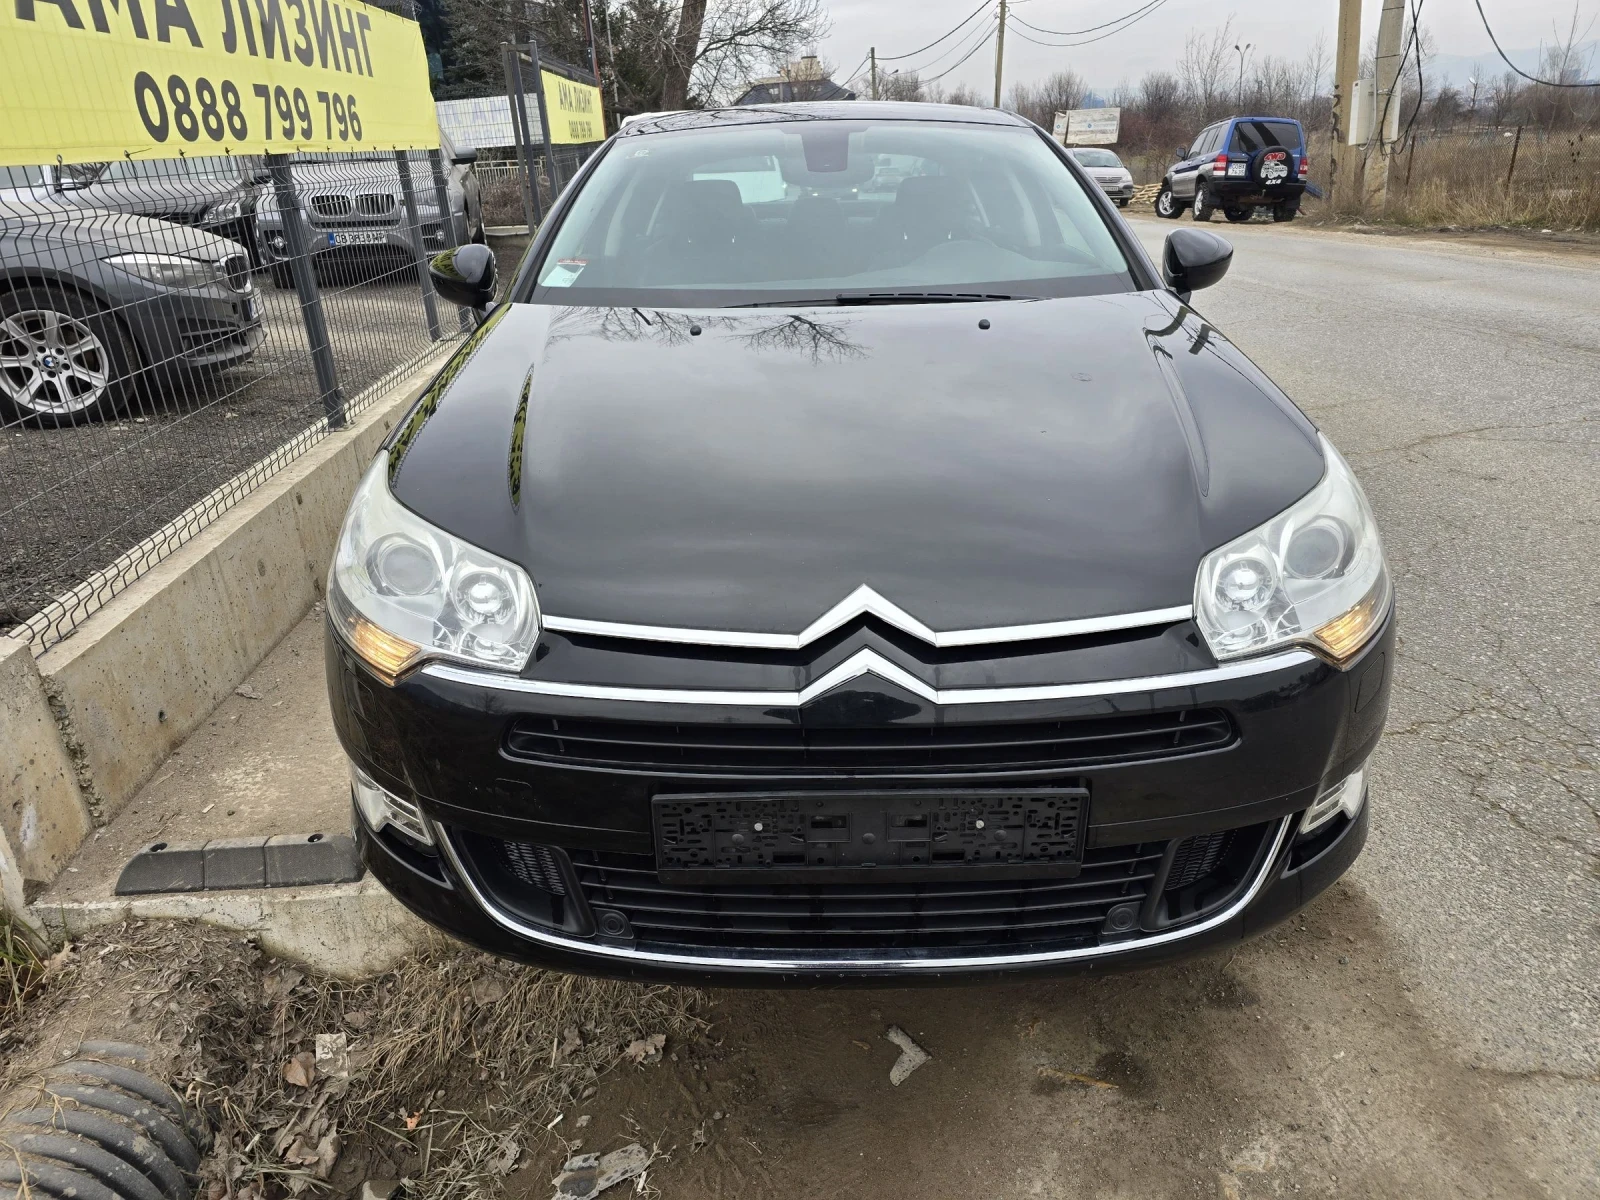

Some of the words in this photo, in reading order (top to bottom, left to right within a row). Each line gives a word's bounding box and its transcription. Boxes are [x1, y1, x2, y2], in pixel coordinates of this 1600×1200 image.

[221, 0, 374, 78] ЛИЗИНГ
[134, 71, 248, 143] 0888
[252, 83, 313, 141] 799
[316, 90, 363, 142] 796
